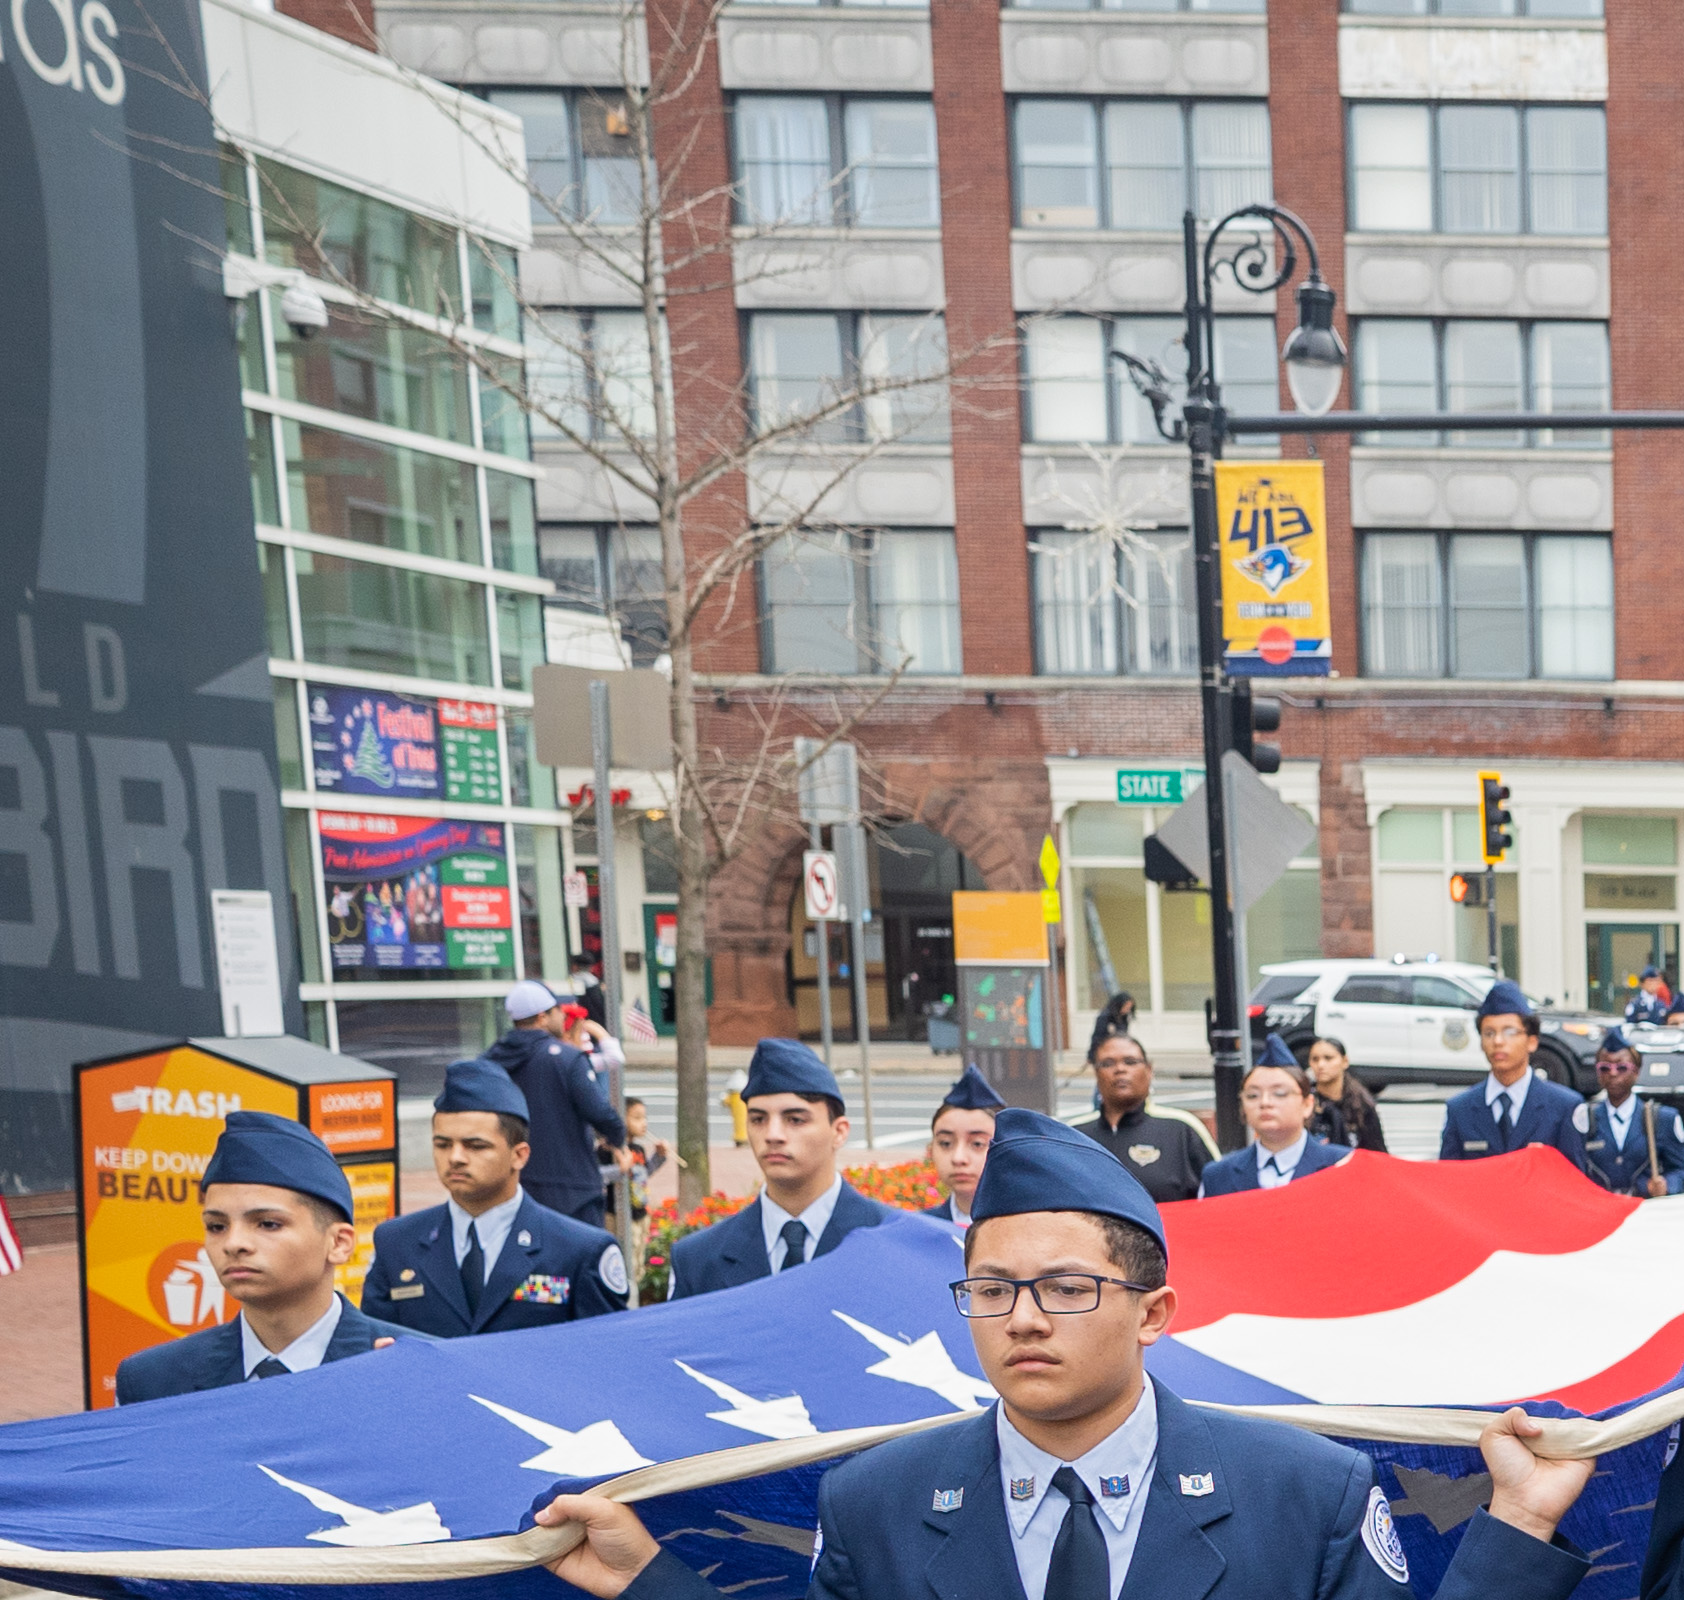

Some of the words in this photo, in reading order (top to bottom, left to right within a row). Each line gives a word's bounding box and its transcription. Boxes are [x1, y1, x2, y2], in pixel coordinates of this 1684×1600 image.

[0, 0, 126, 106] as
[1230, 507, 1313, 552] 413
[1120, 774, 1171, 798] STATE
[134, 1086, 241, 1119] TRASH
[95, 1147, 148, 1169] KEEP
